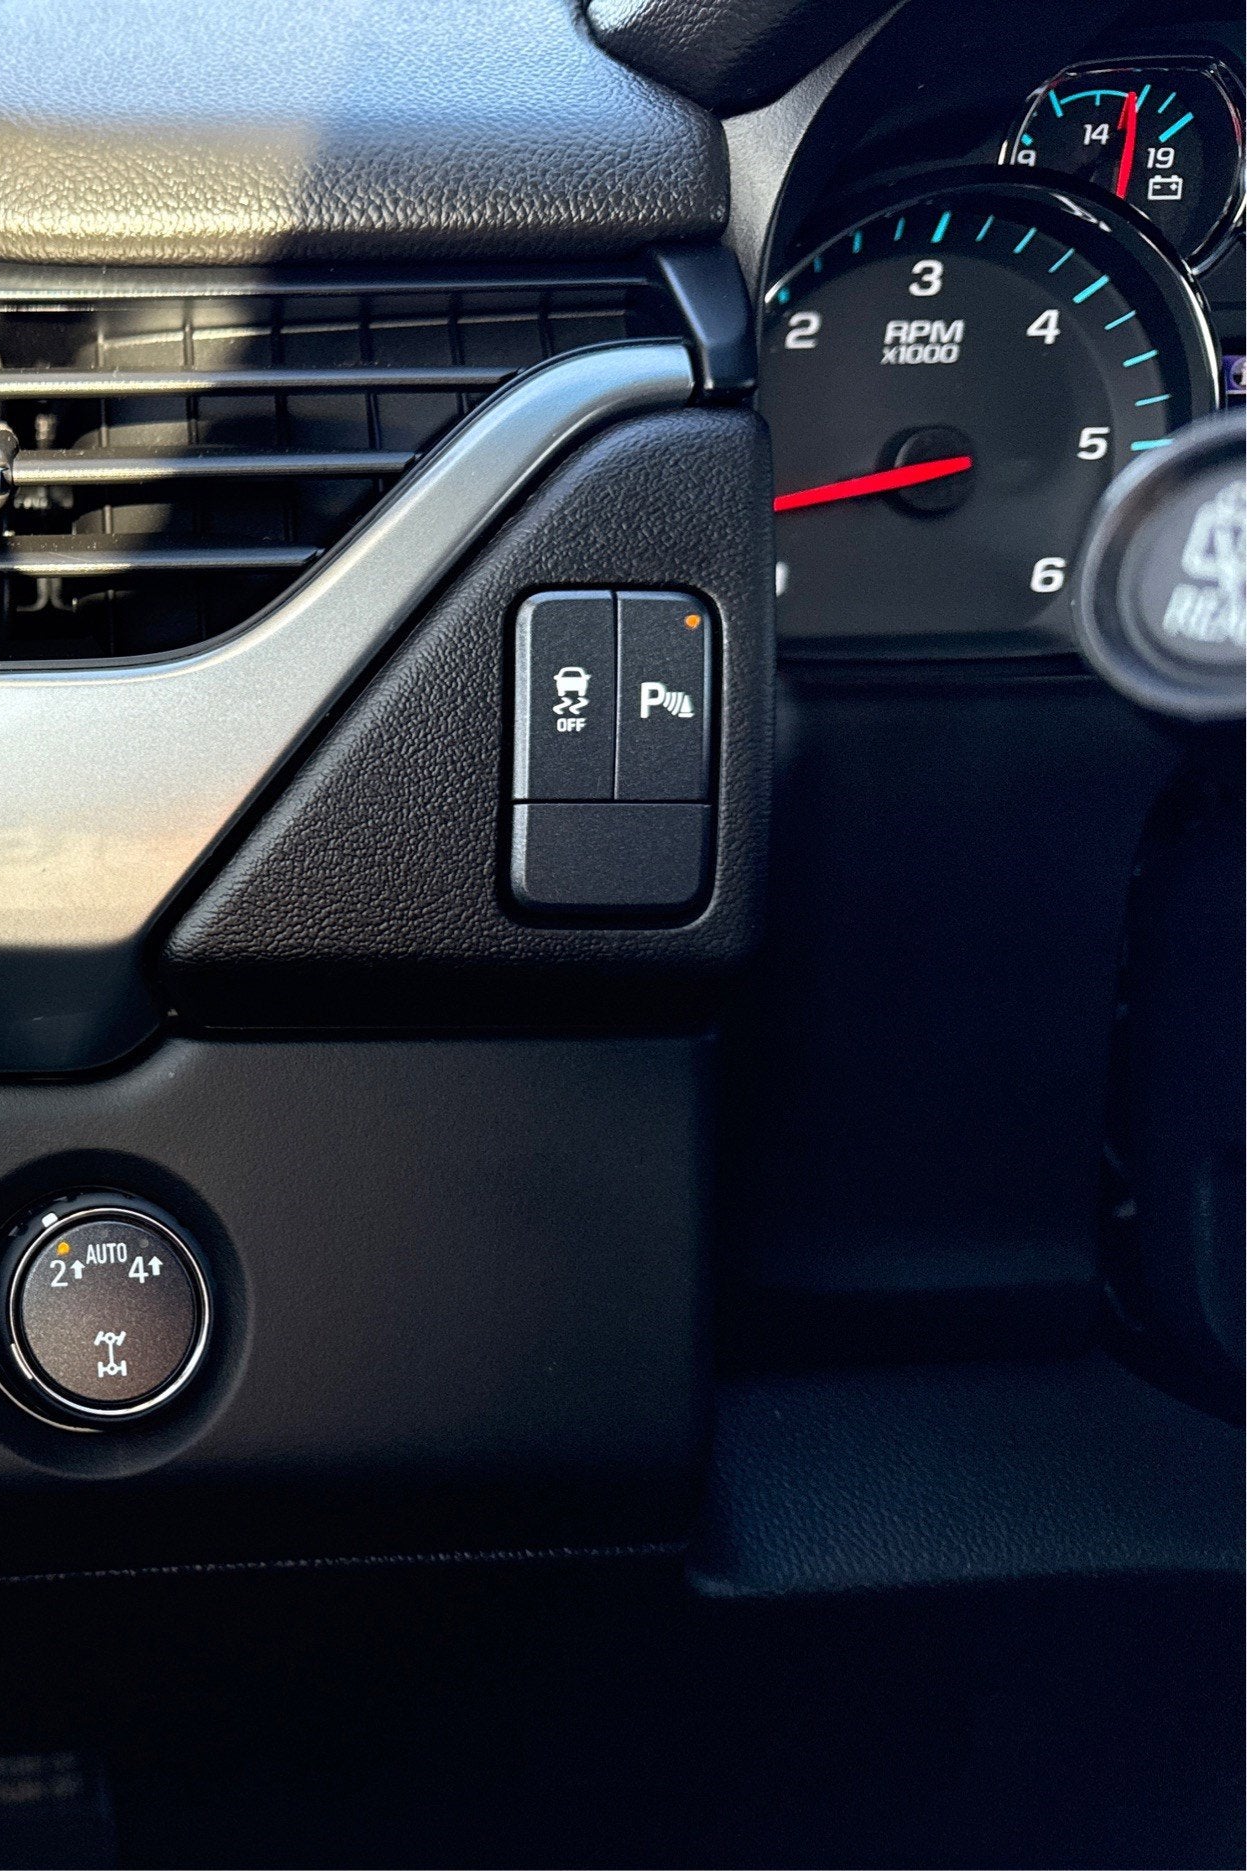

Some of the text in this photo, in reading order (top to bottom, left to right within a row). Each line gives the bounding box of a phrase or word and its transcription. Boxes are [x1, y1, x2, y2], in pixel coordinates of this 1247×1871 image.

[1084, 124, 1110, 145] 14
[1017, 149, 1037, 167] 9
[1146, 147, 1175, 169] 19
[909, 260, 943, 297] 3
[785, 311, 821, 349] 2
[884, 319, 965, 345] RPM
[1026, 309, 1061, 344] 4
[1076, 426, 1110, 461] 5
[1030, 556, 1066, 593] 6
[556, 717, 587, 732] OFF
[86, 1242, 128, 1265] AUTO
[50, 1259, 69, 1287] 2
[128, 1256, 149, 1284] 4
